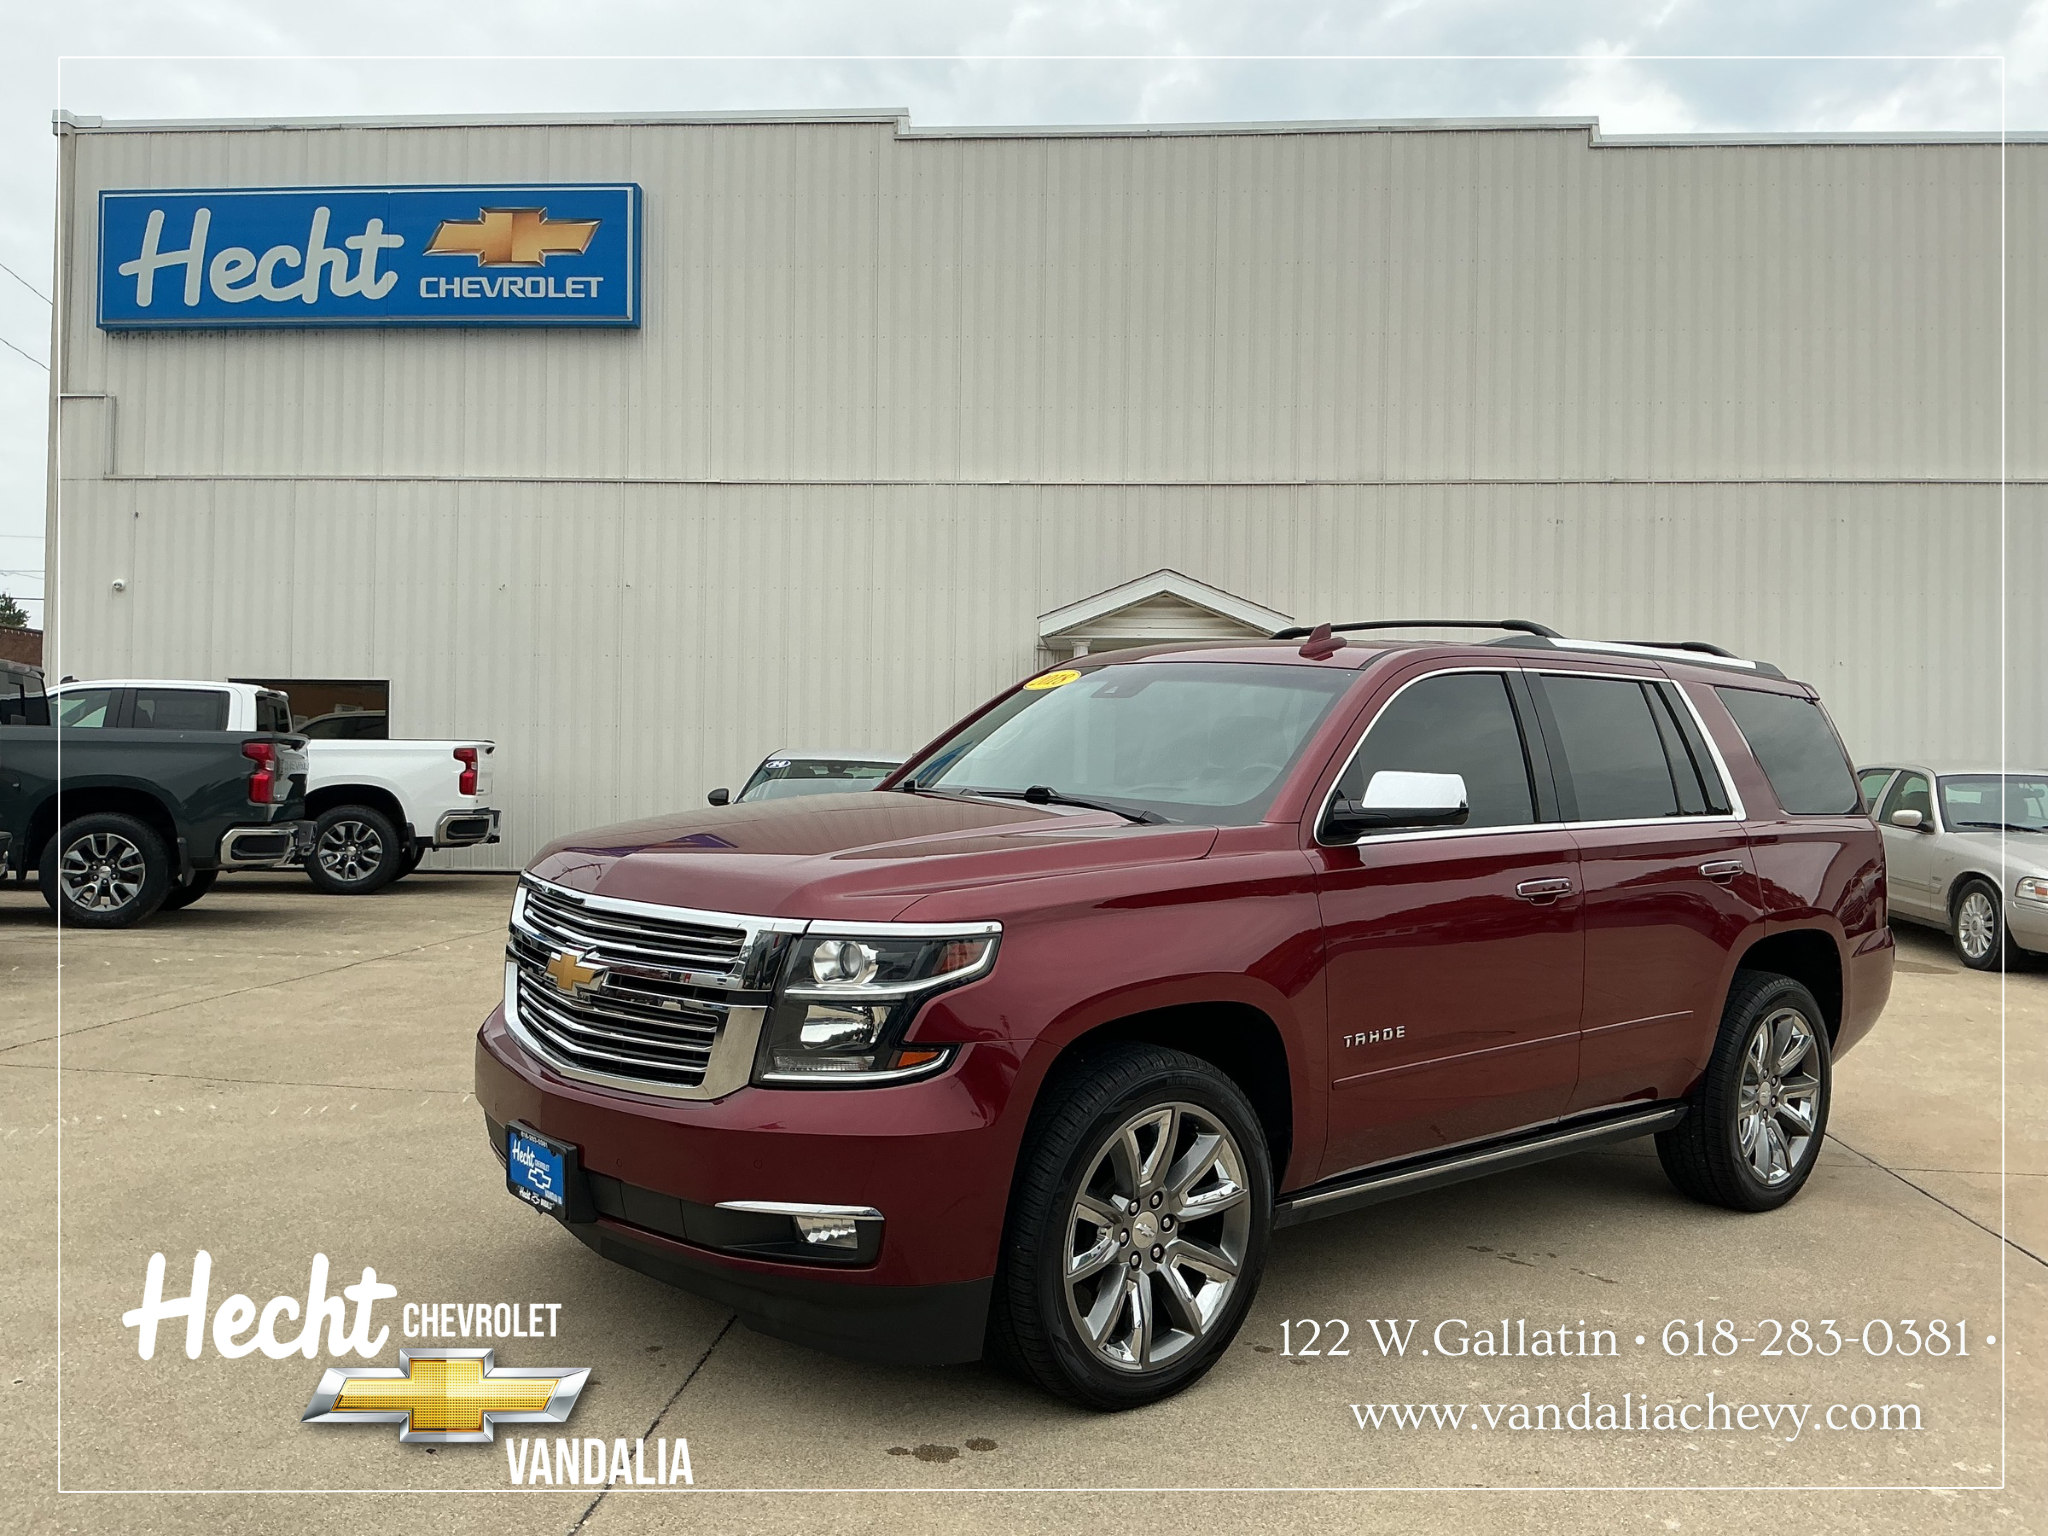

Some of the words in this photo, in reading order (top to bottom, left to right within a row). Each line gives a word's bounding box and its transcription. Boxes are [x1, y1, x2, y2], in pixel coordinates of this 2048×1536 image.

[118, 206, 404, 307] Hecht
[419, 276, 604, 298] CHEVROLET
[1343, 1025, 1405, 1048] TAHOE
[511, 1139, 536, 1168] Hecht
